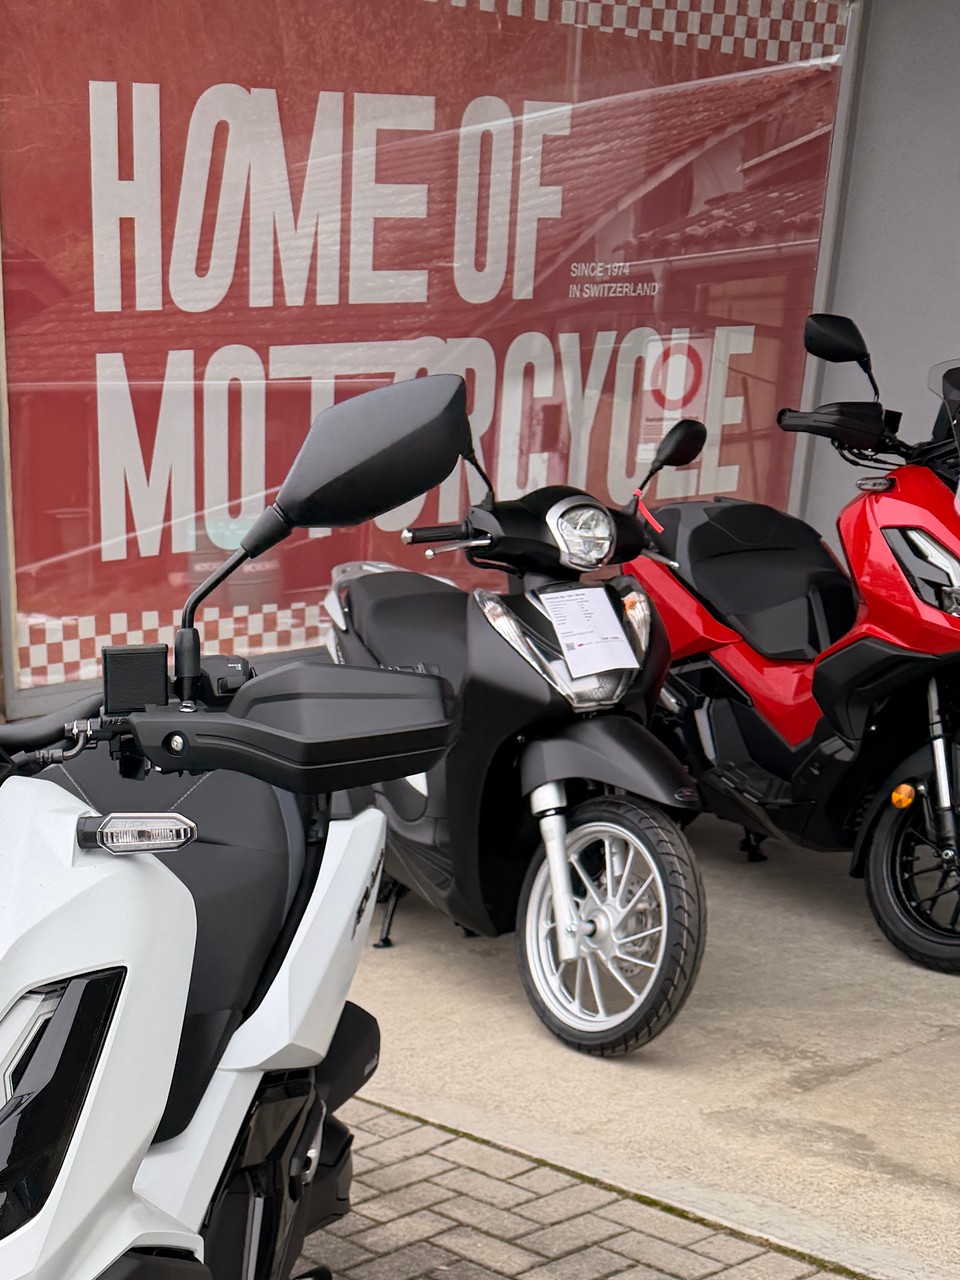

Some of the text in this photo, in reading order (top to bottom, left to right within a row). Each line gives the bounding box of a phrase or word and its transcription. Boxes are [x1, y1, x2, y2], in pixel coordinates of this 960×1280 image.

[89, 80, 572, 313] HOME OF
[570, 262, 630, 277] SINCE 1974
[568, 282, 659, 298] IN SWITZERLAND
